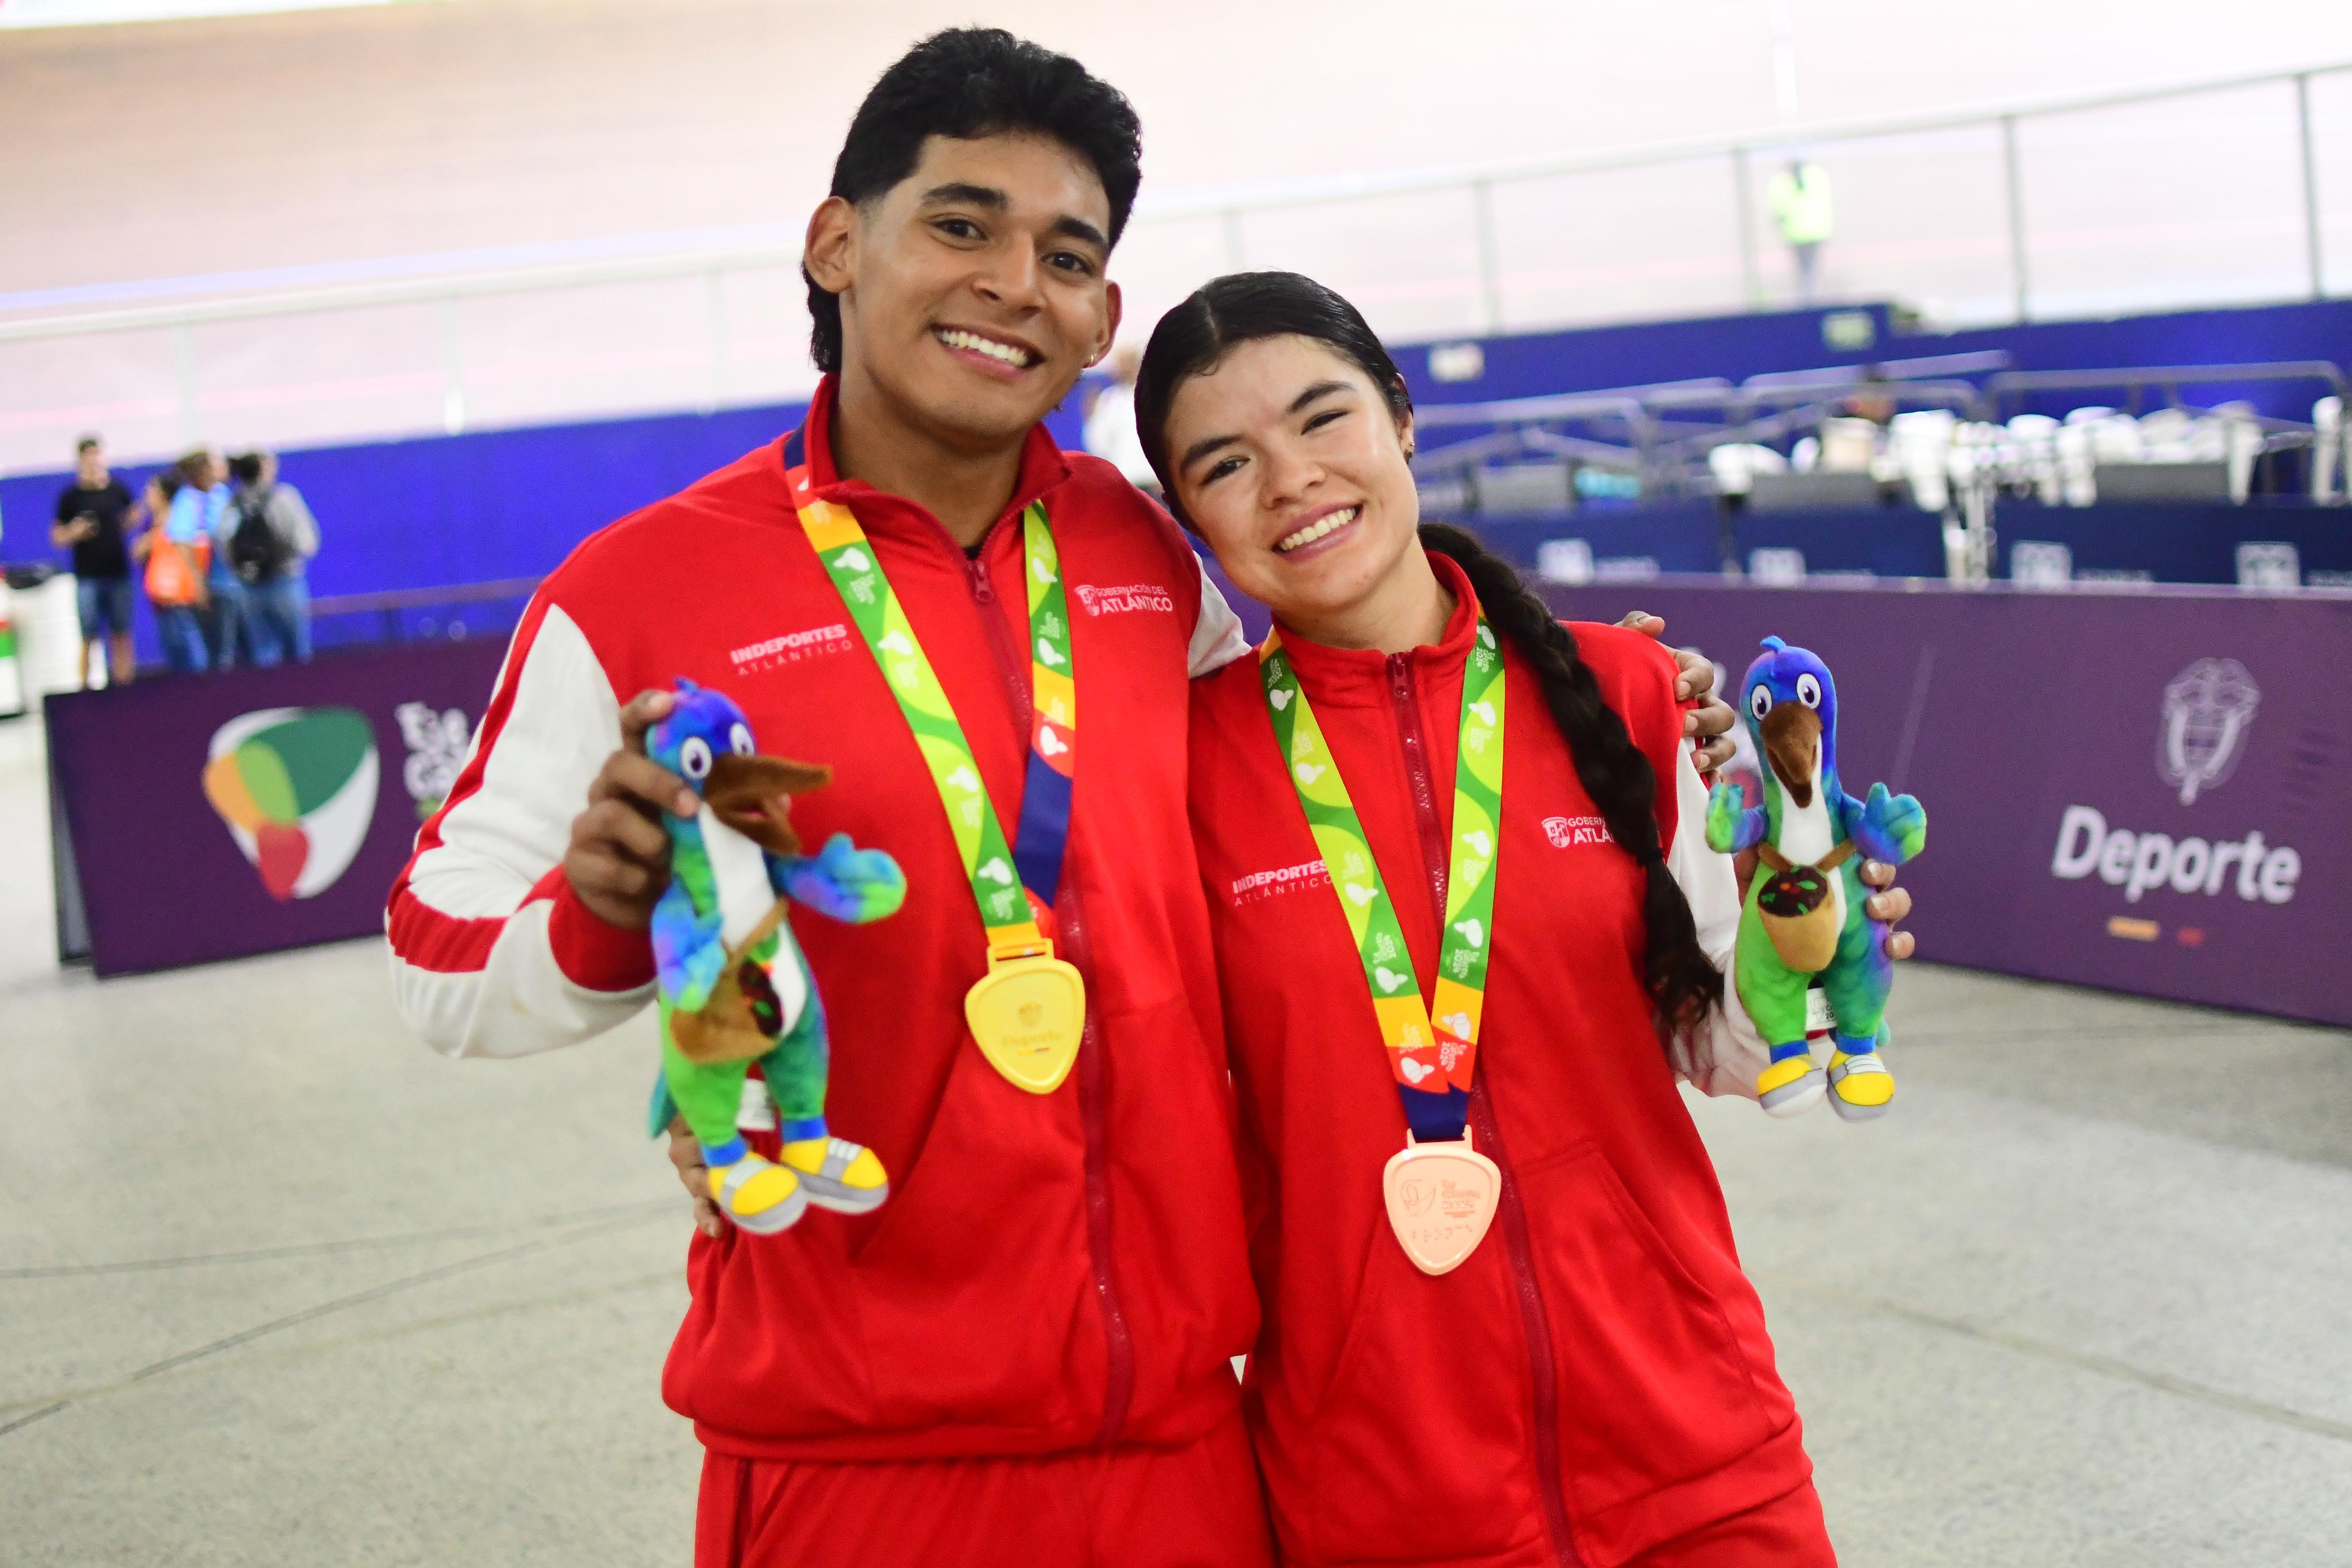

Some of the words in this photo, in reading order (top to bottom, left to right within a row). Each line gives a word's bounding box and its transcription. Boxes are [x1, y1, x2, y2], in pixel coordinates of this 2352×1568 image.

[1152, 586, 1168, 595] DEL
[730, 623, 848, 664] INDEPORTES
[1573, 824, 1615, 844] ATLÁ
[2051, 803, 2302, 904] Deporte
[1233, 859, 1328, 894] INDEPORTES
